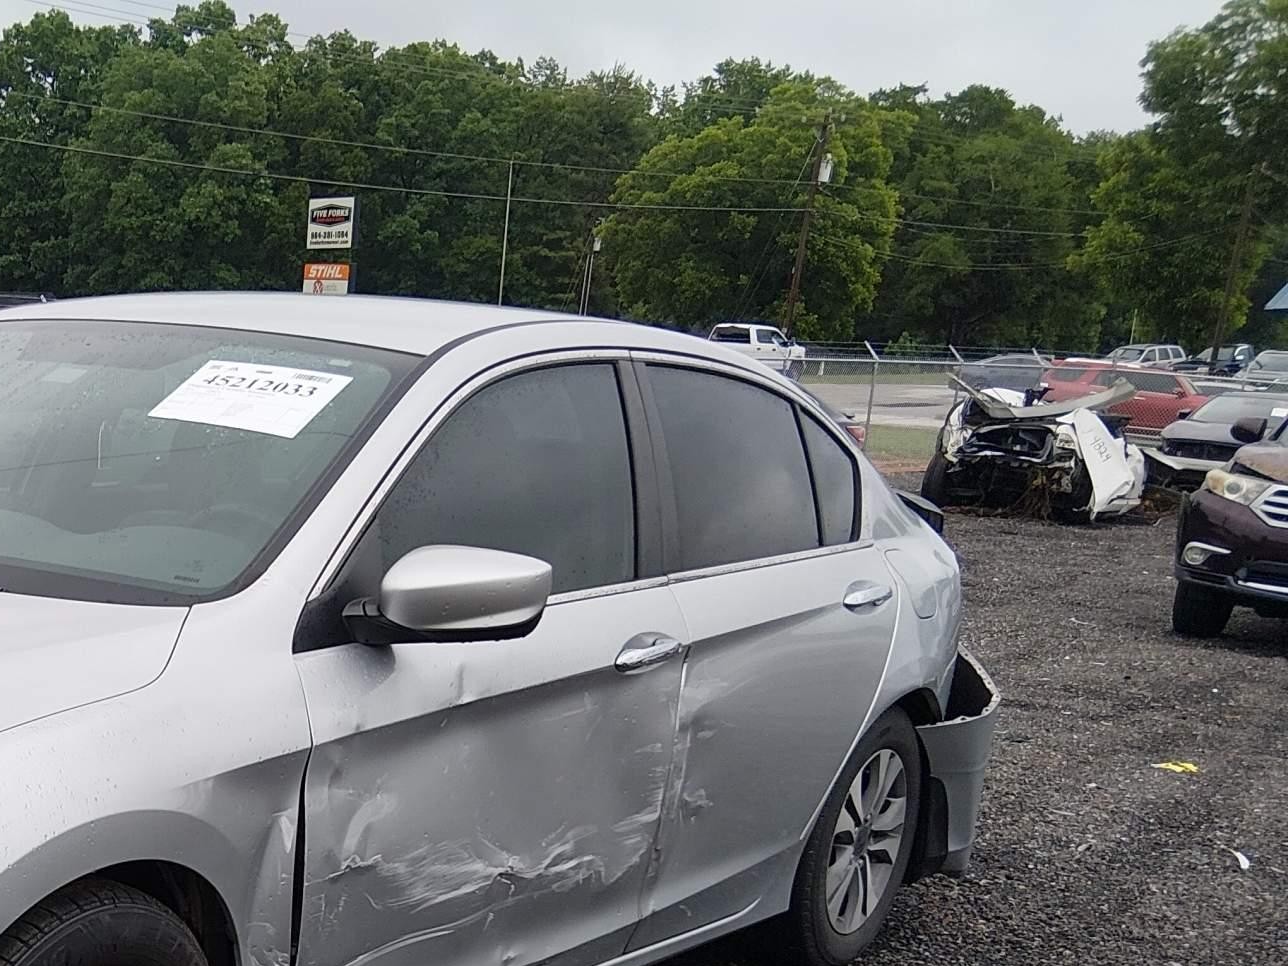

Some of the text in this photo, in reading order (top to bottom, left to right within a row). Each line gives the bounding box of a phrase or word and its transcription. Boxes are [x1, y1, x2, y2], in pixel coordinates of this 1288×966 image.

[313, 208, 349, 218] FIVE FORKS
[309, 264, 342, 278] STIHL
[203, 374, 317, 396] 45212033
